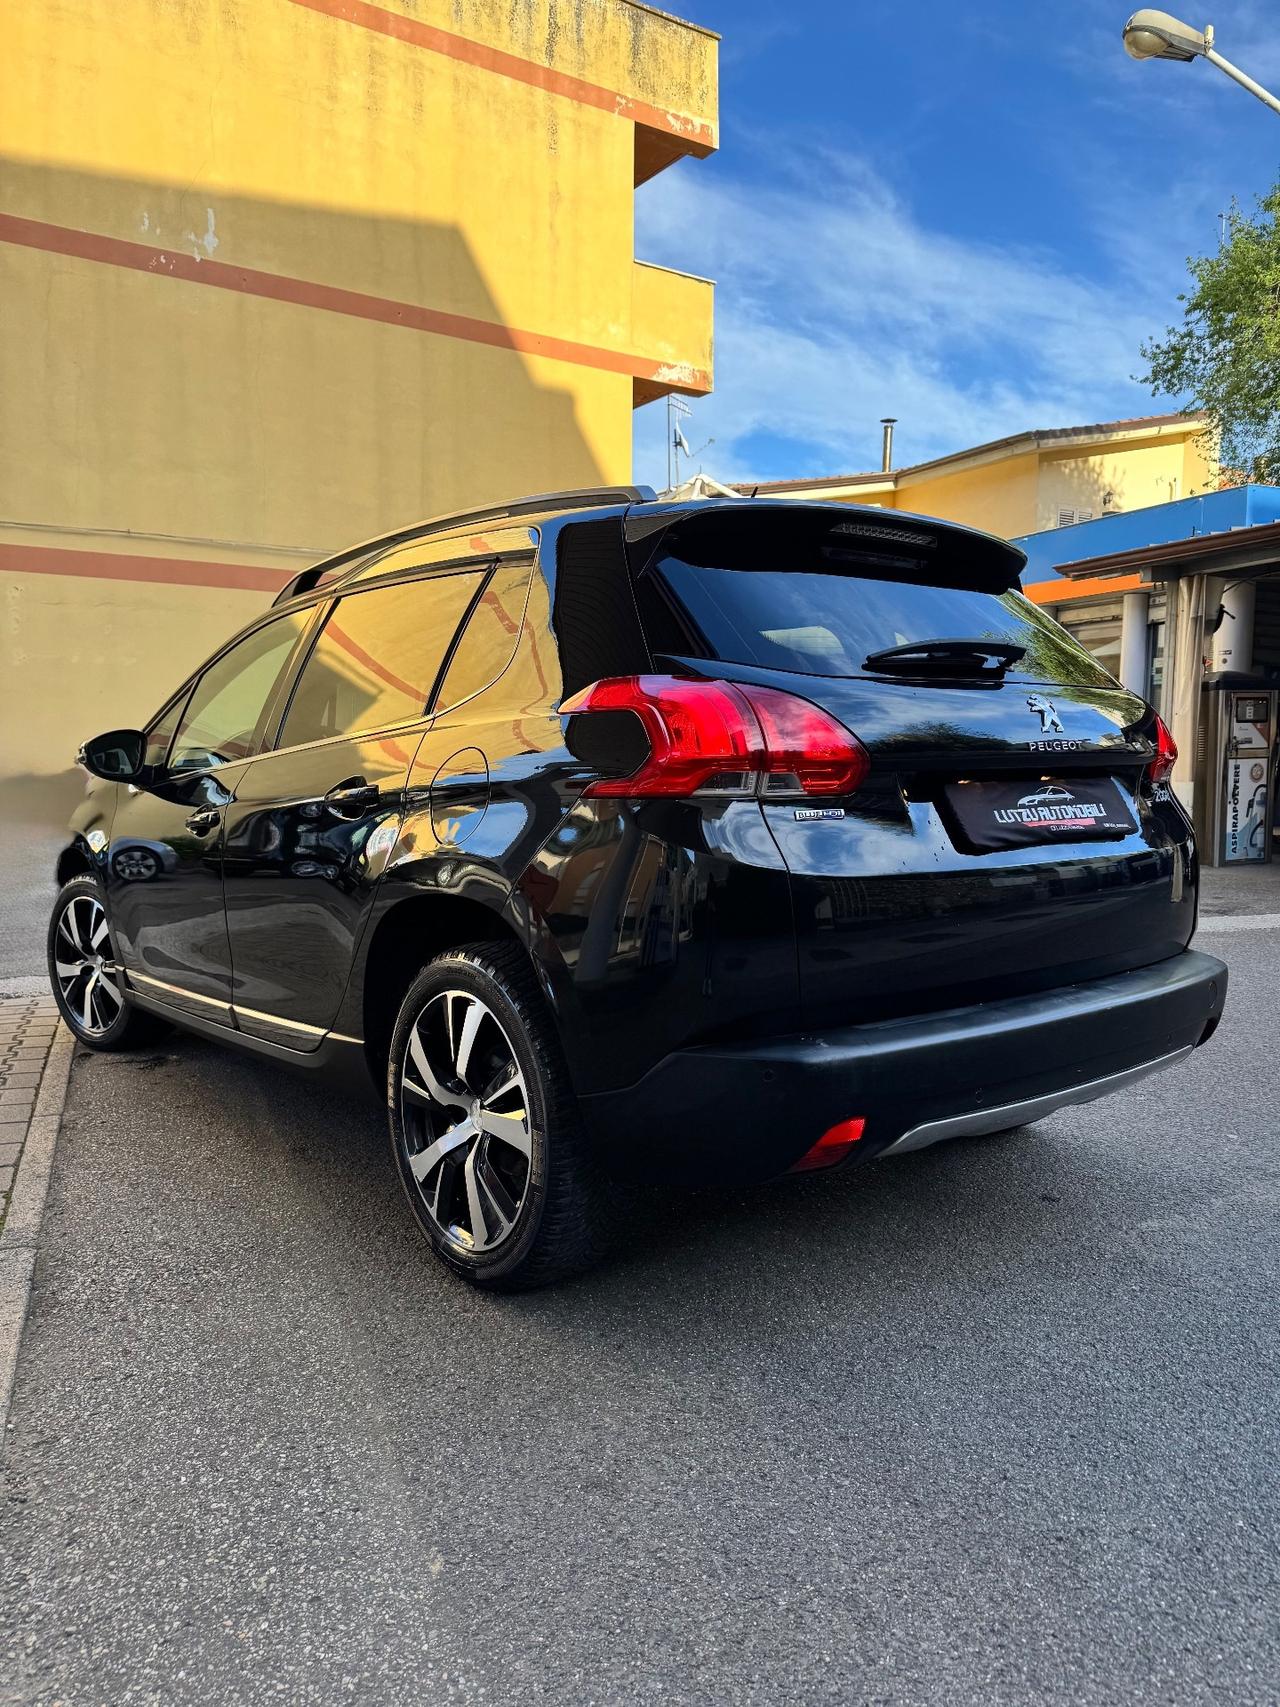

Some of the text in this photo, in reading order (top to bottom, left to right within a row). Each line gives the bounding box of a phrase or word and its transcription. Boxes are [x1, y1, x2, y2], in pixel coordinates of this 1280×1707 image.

[1029, 741, 1083, 752] PEUGEOT
[993, 803, 1107, 823] LUTZU AUTOMOBILI
[1231, 763, 1241, 854] ASPIRAPOLVERE
